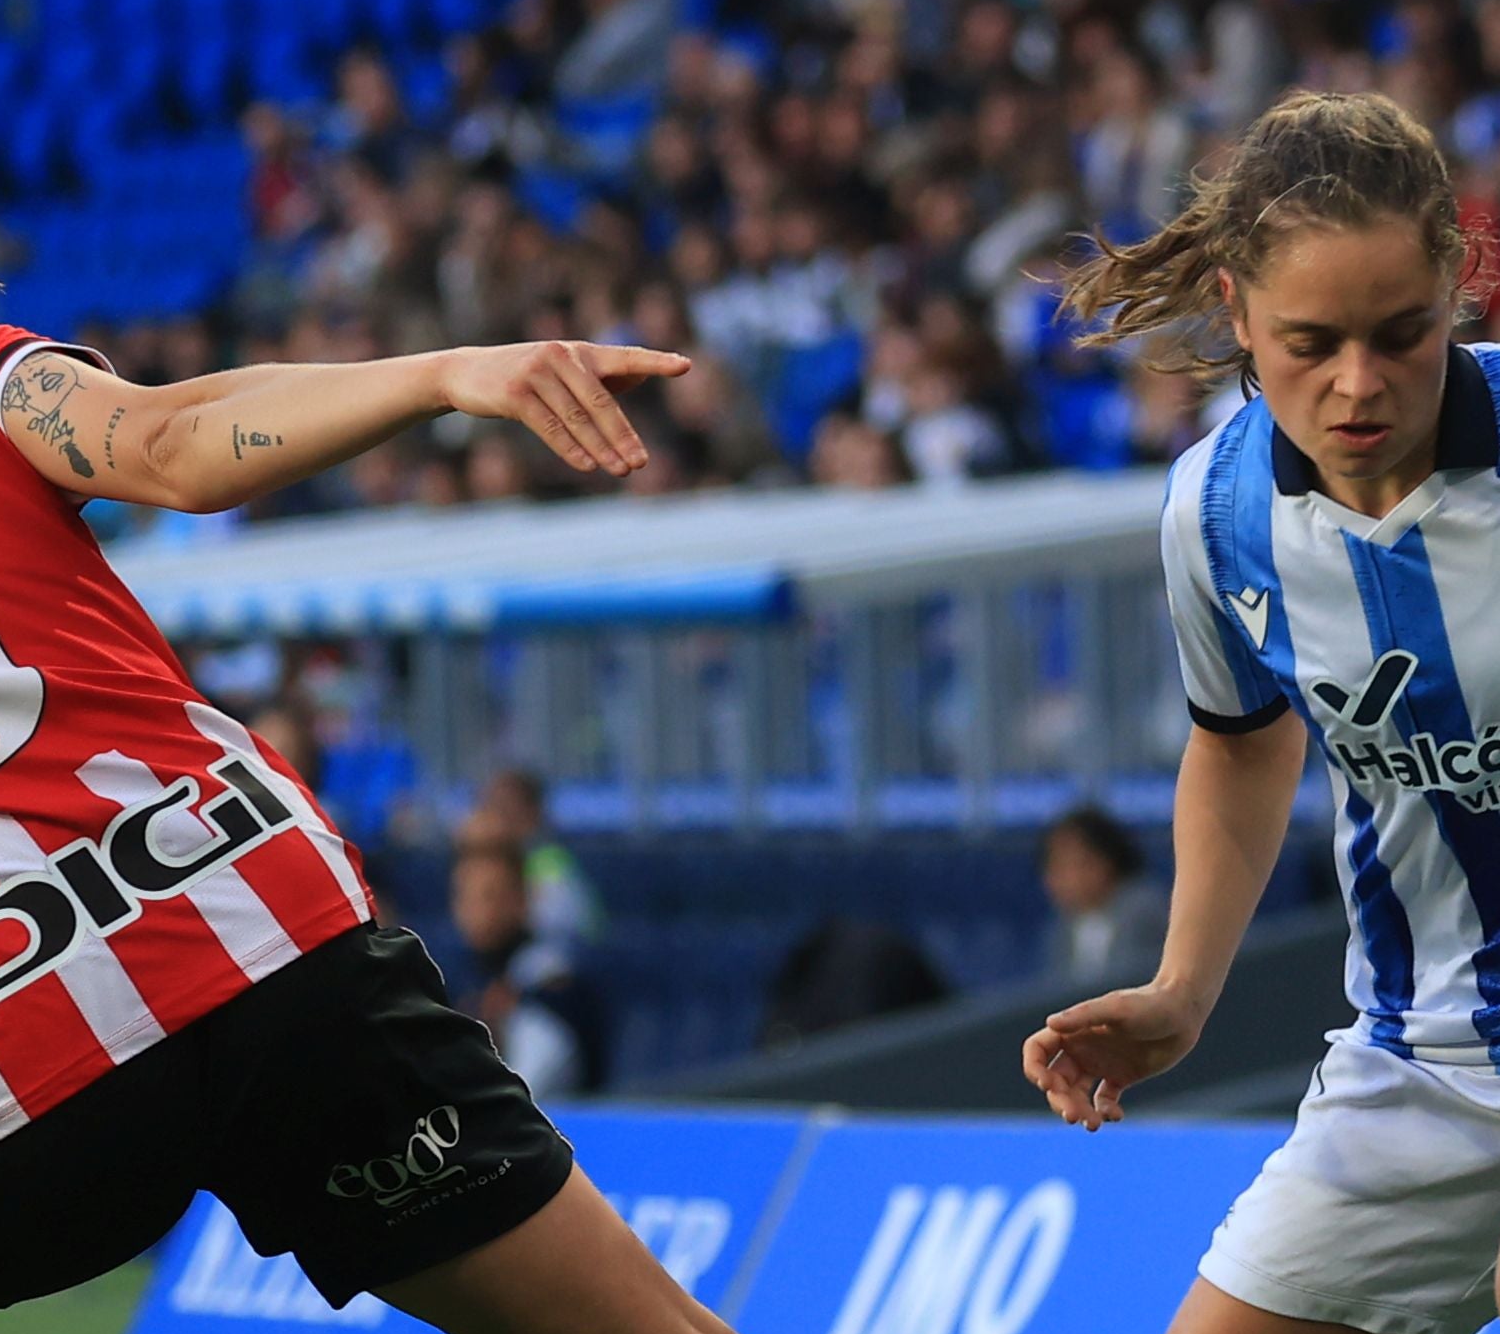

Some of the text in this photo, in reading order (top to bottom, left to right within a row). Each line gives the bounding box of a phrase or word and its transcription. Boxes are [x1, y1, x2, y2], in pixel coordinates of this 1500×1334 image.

[326, 1104, 467, 1208] eggo
[386, 1192, 450, 1227] KITCHEN
[467, 1157, 513, 1191] HOUSE
